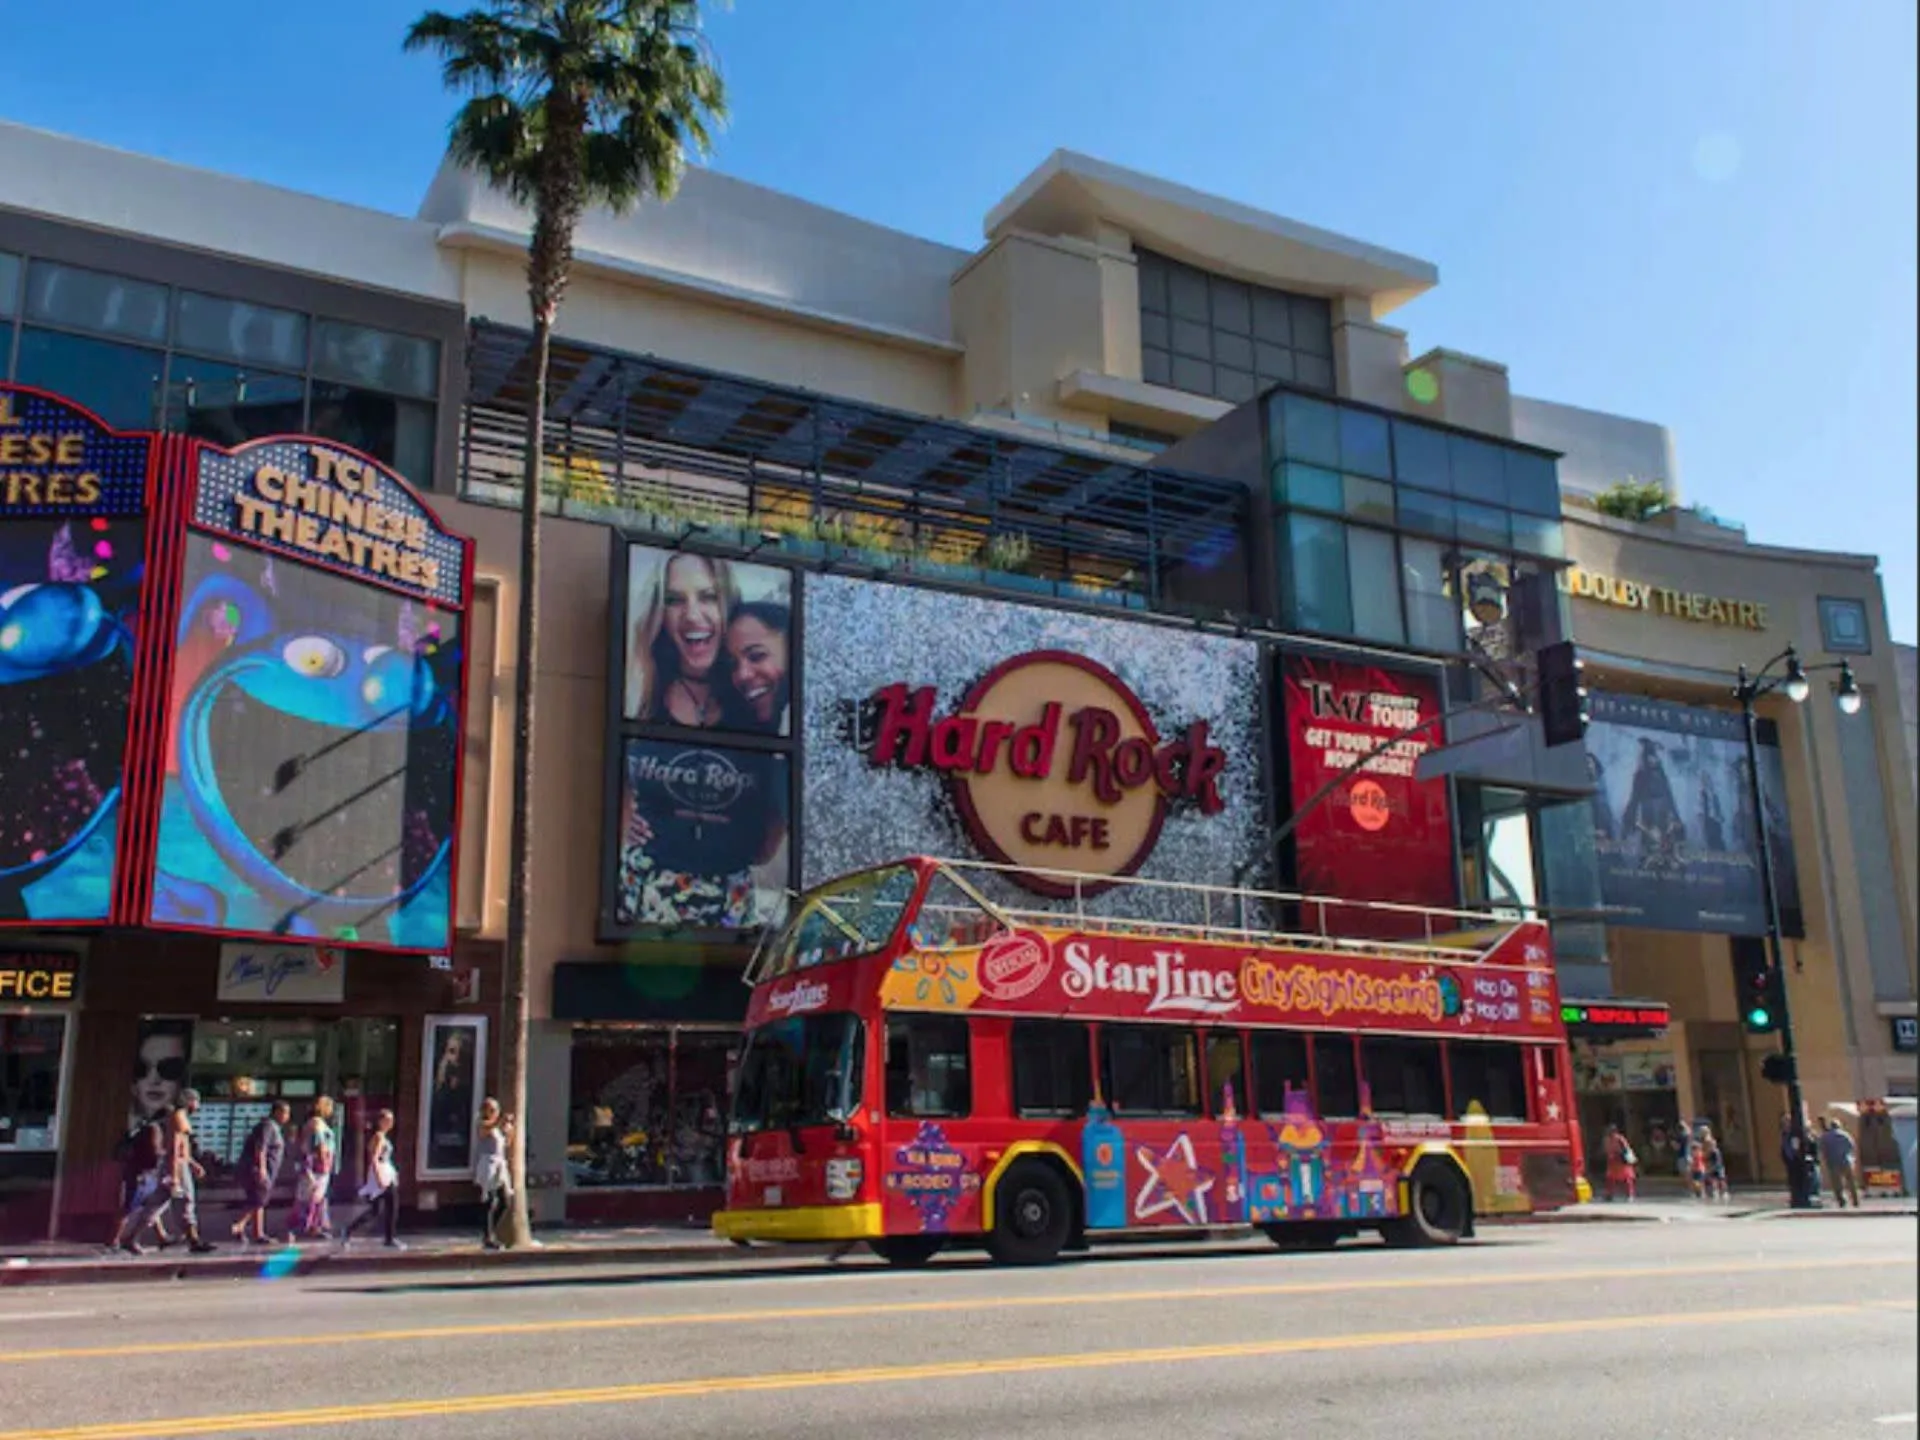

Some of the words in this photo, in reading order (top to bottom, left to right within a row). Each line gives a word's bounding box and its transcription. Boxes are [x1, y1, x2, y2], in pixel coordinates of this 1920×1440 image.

[311, 445, 382, 500] TCL
[255, 465, 427, 549] CHINESE
[235, 493, 440, 589] THEATRES
[1573, 568, 1651, 610] DOLBY
[1657, 588, 1770, 629] THEATRE
[1304, 727, 1332, 747] GET
[1335, 731, 1372, 753] YOUR
[1371, 704, 1419, 730] TOUR
[866, 683, 1062, 778] Hard
[1067, 706, 1226, 817] Rock
[1019, 811, 1110, 850] CAFE
[1475, 978, 1498, 998] Hop
[1501, 979, 1518, 998] On
